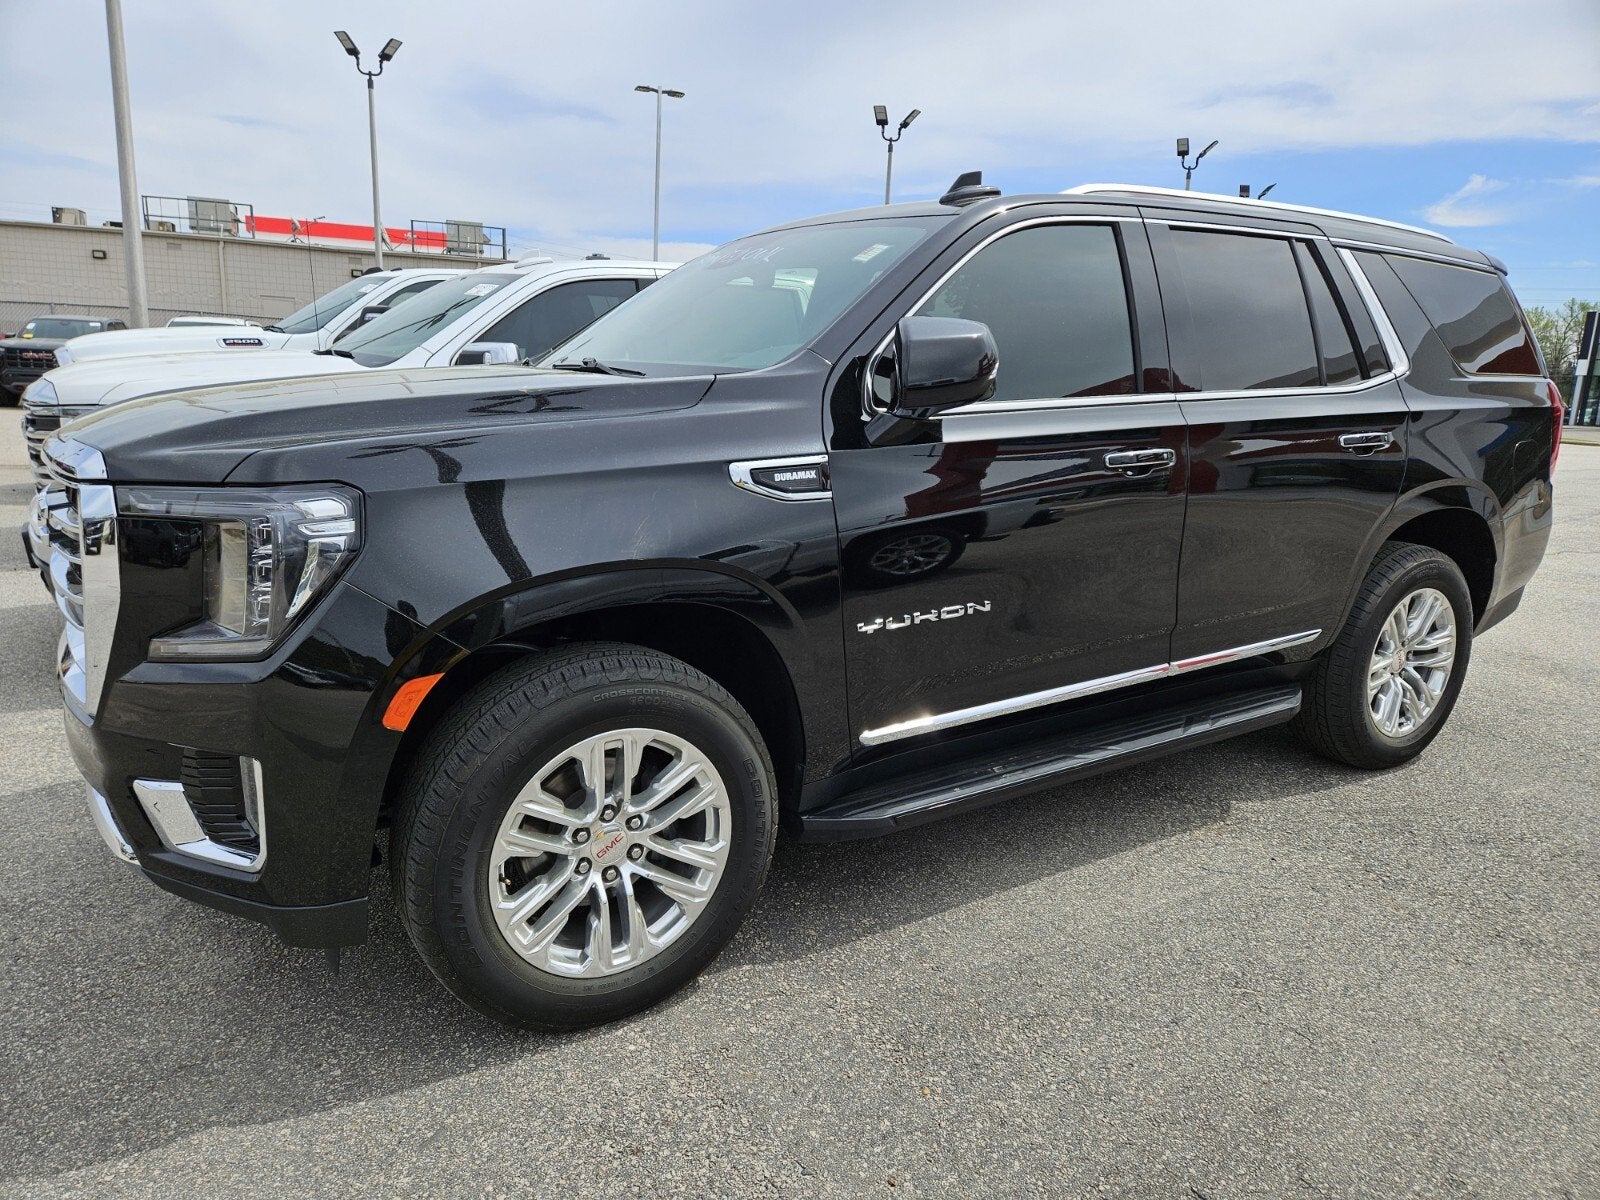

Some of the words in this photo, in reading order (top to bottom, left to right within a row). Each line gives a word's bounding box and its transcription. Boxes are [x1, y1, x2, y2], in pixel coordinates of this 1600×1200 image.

[774, 469, 817, 482] DURAMAX
[857, 600, 992, 634] YUKON
[592, 687, 689, 703] CROSSCONTACT
[596, 832, 624, 858] GMC
